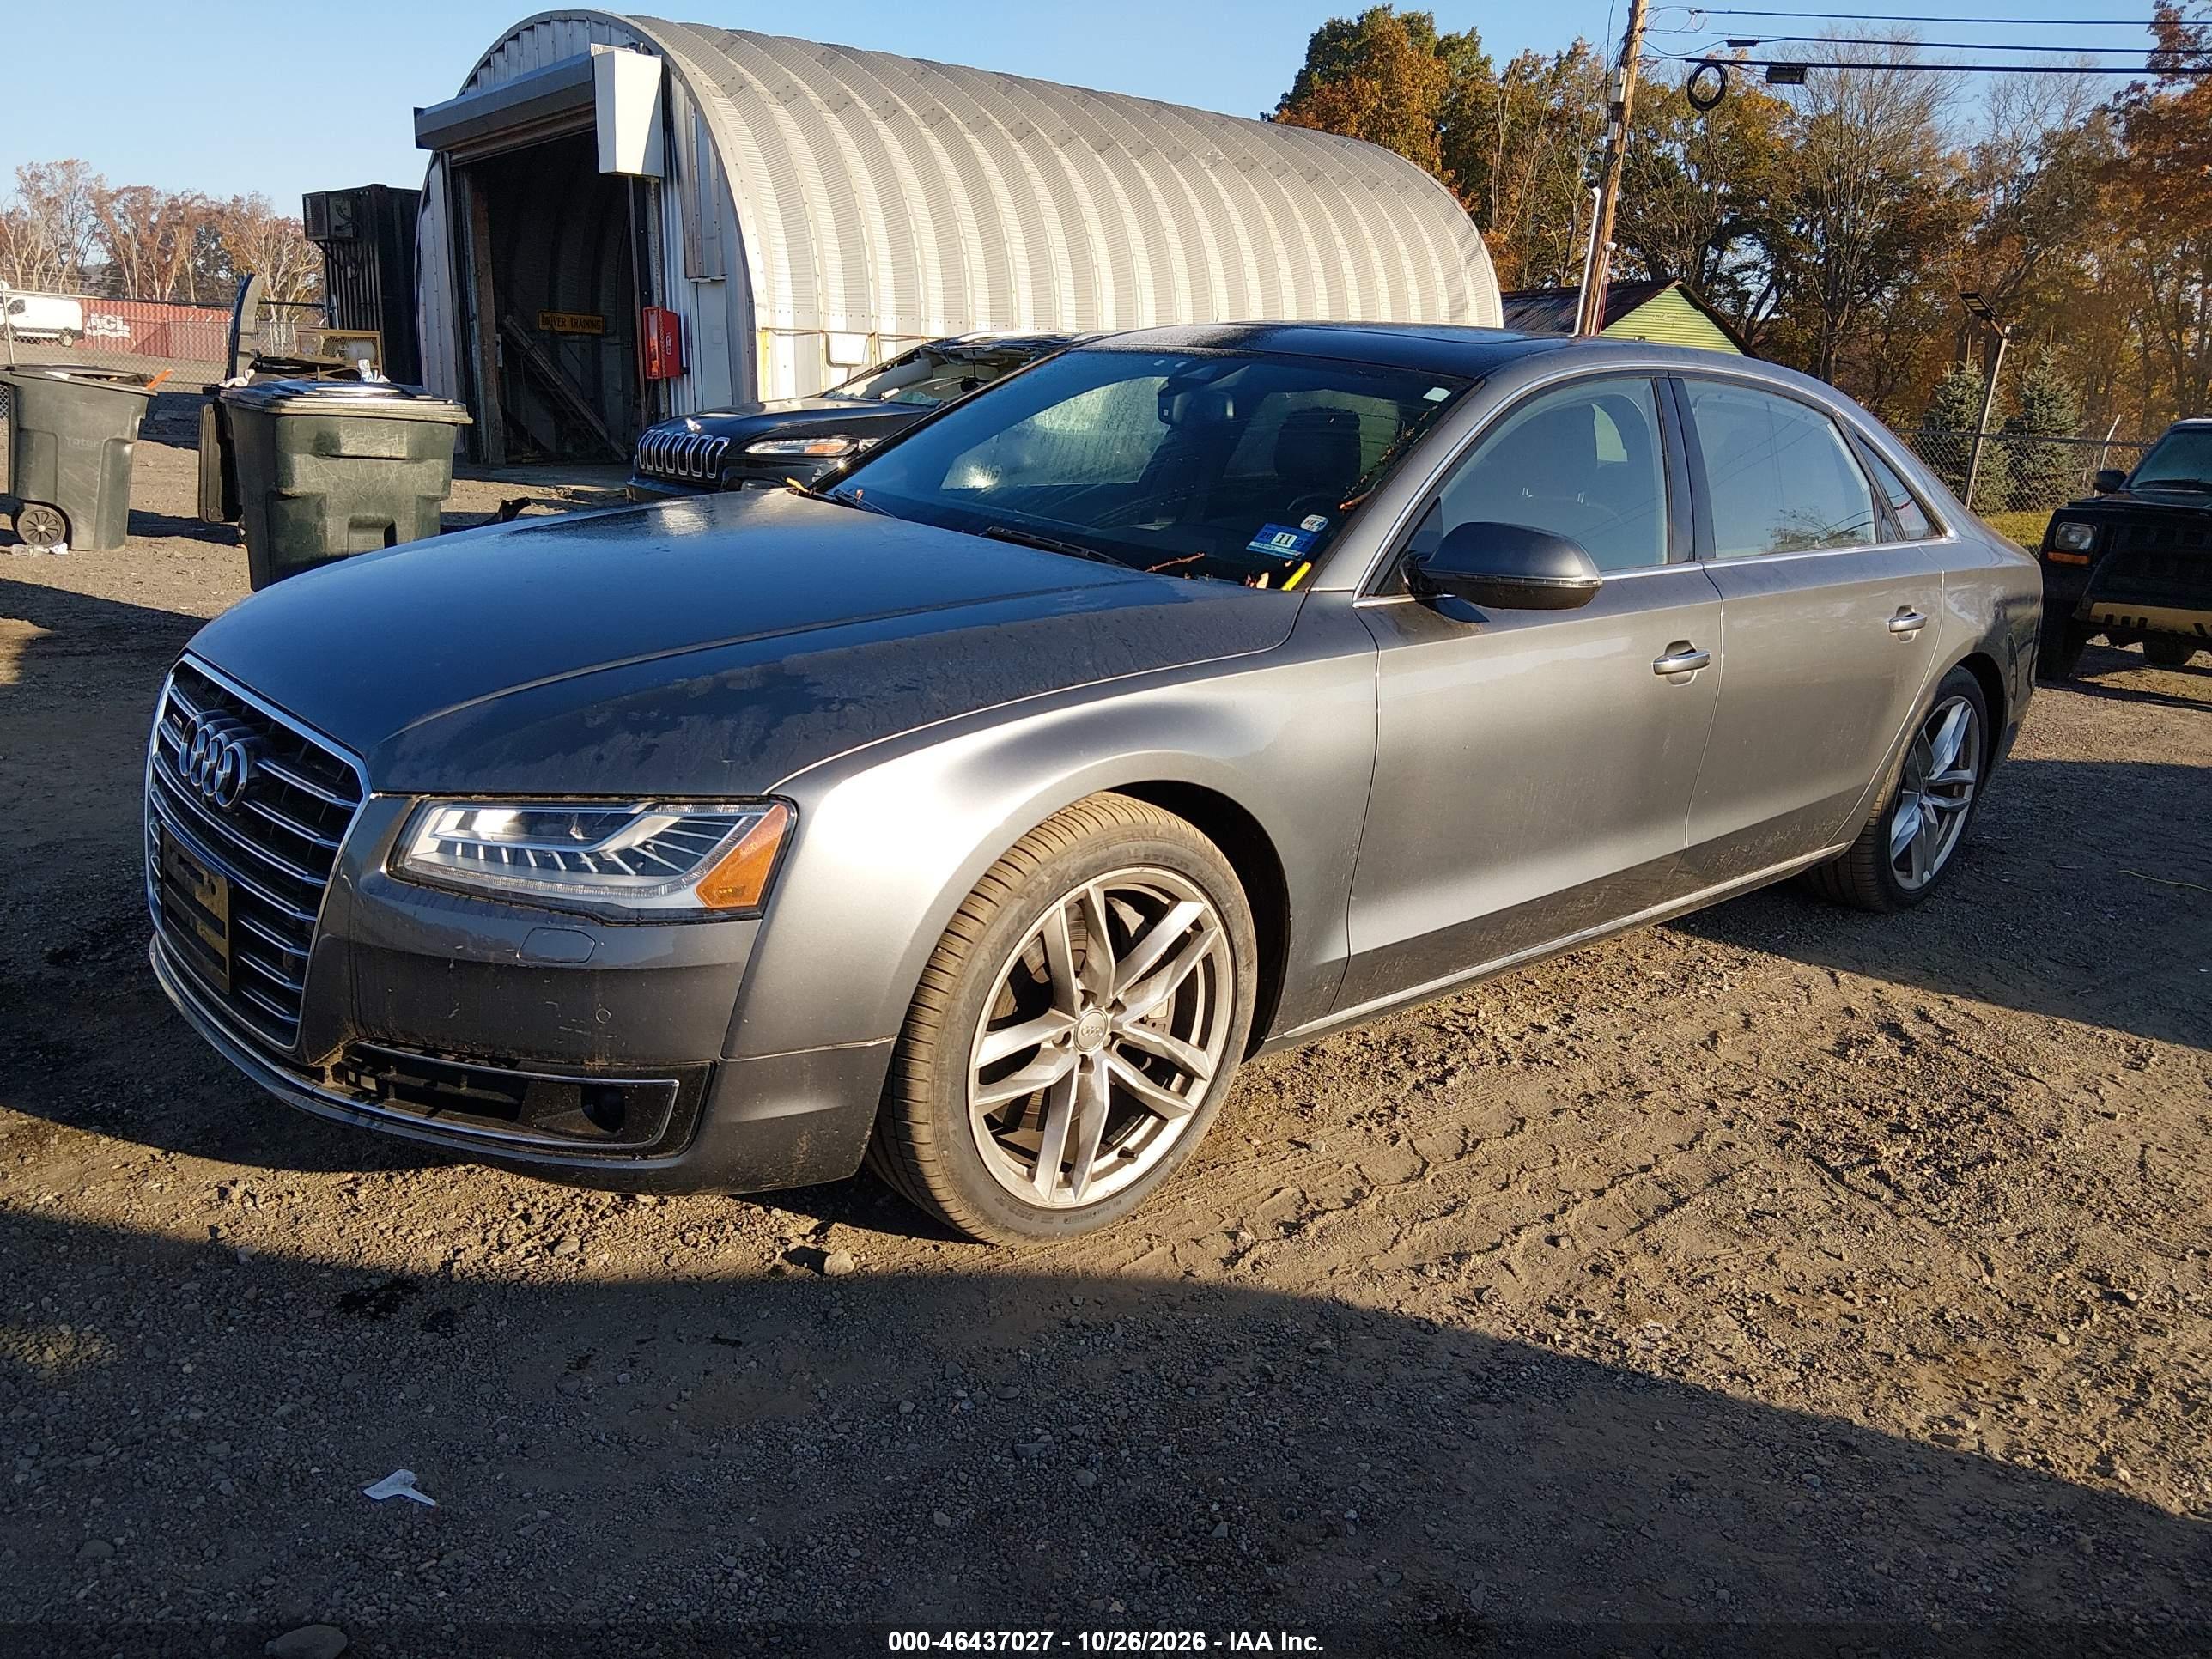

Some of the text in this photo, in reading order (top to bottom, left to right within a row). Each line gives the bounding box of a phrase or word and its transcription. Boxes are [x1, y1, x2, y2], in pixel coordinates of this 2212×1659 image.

[87, 313, 131, 331] ACL
[542, 313, 602, 331] DRIVER TRAINING
[1275, 533, 1293, 545] 11
